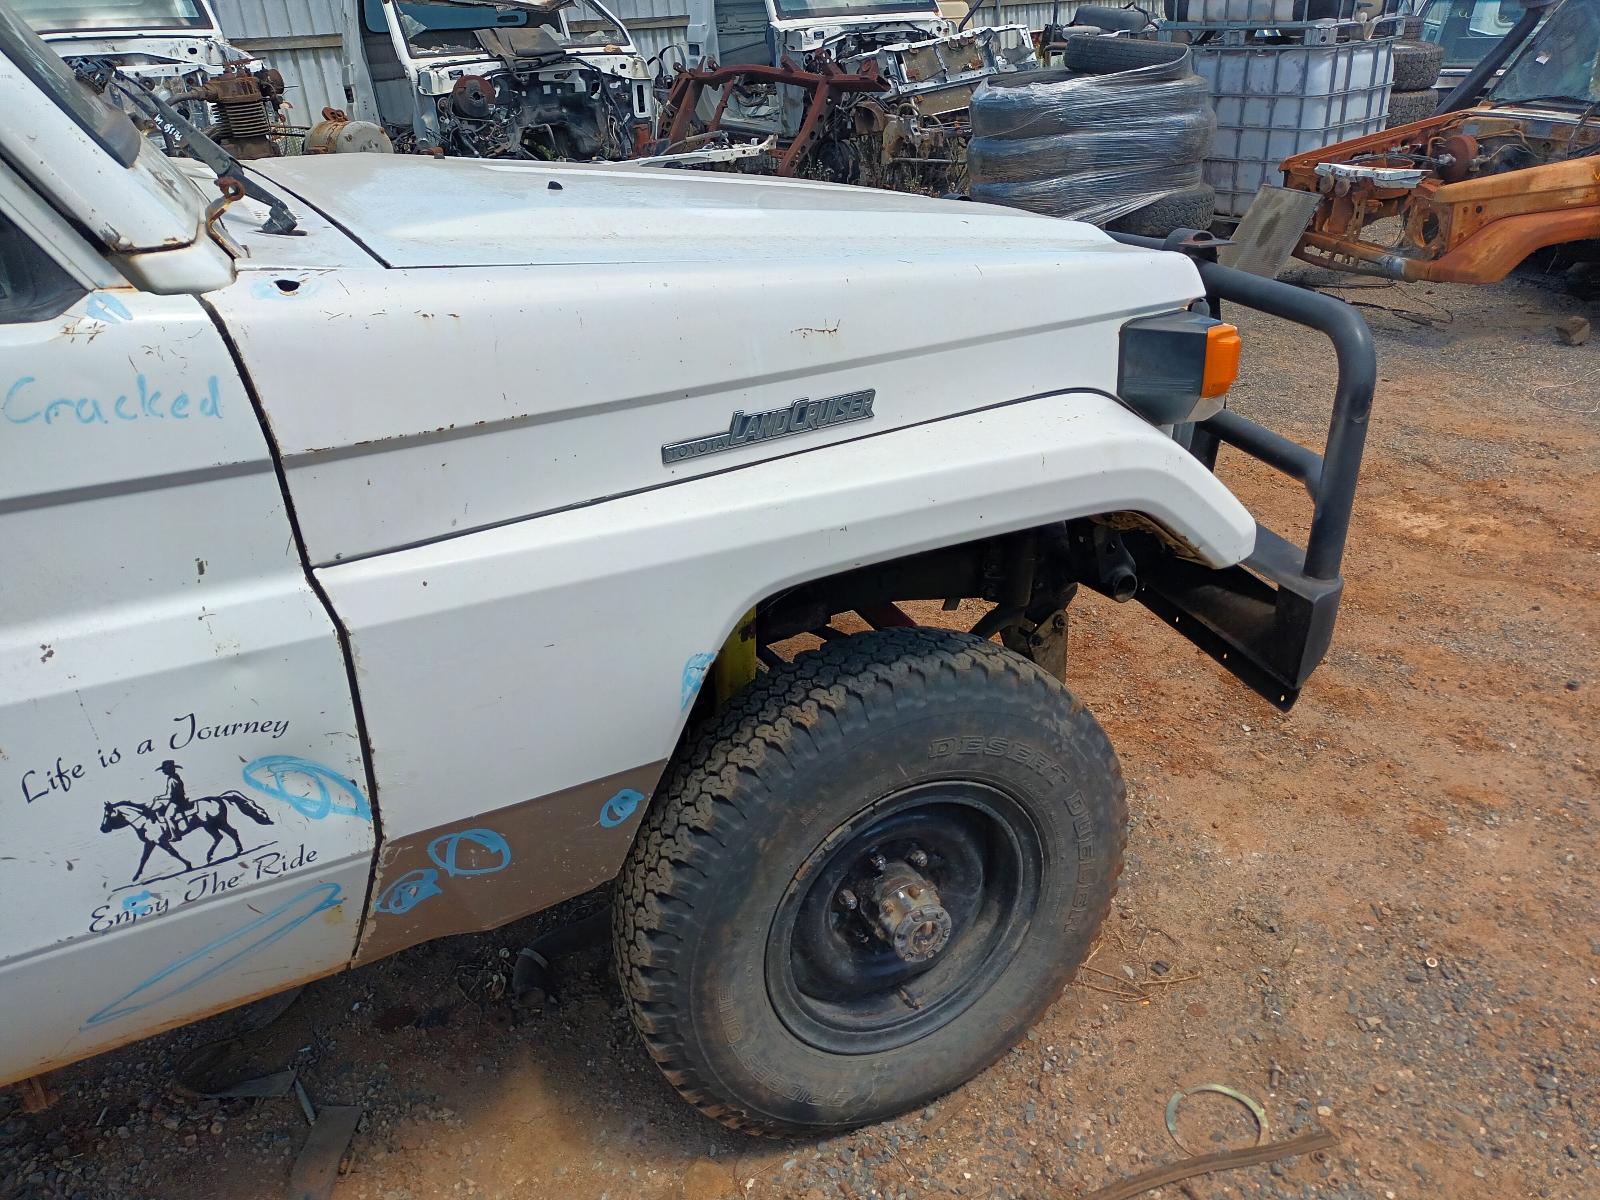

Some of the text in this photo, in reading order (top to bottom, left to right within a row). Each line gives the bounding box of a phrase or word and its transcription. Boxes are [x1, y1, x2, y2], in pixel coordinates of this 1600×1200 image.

[3, 374, 223, 424] Cracked
[667, 437, 728, 461] TOYOTA
[22, 713, 289, 803] Life is a Journey
[927, 736, 1071, 787] DESERT
[89, 844, 318, 933] Enjoy The Ride
